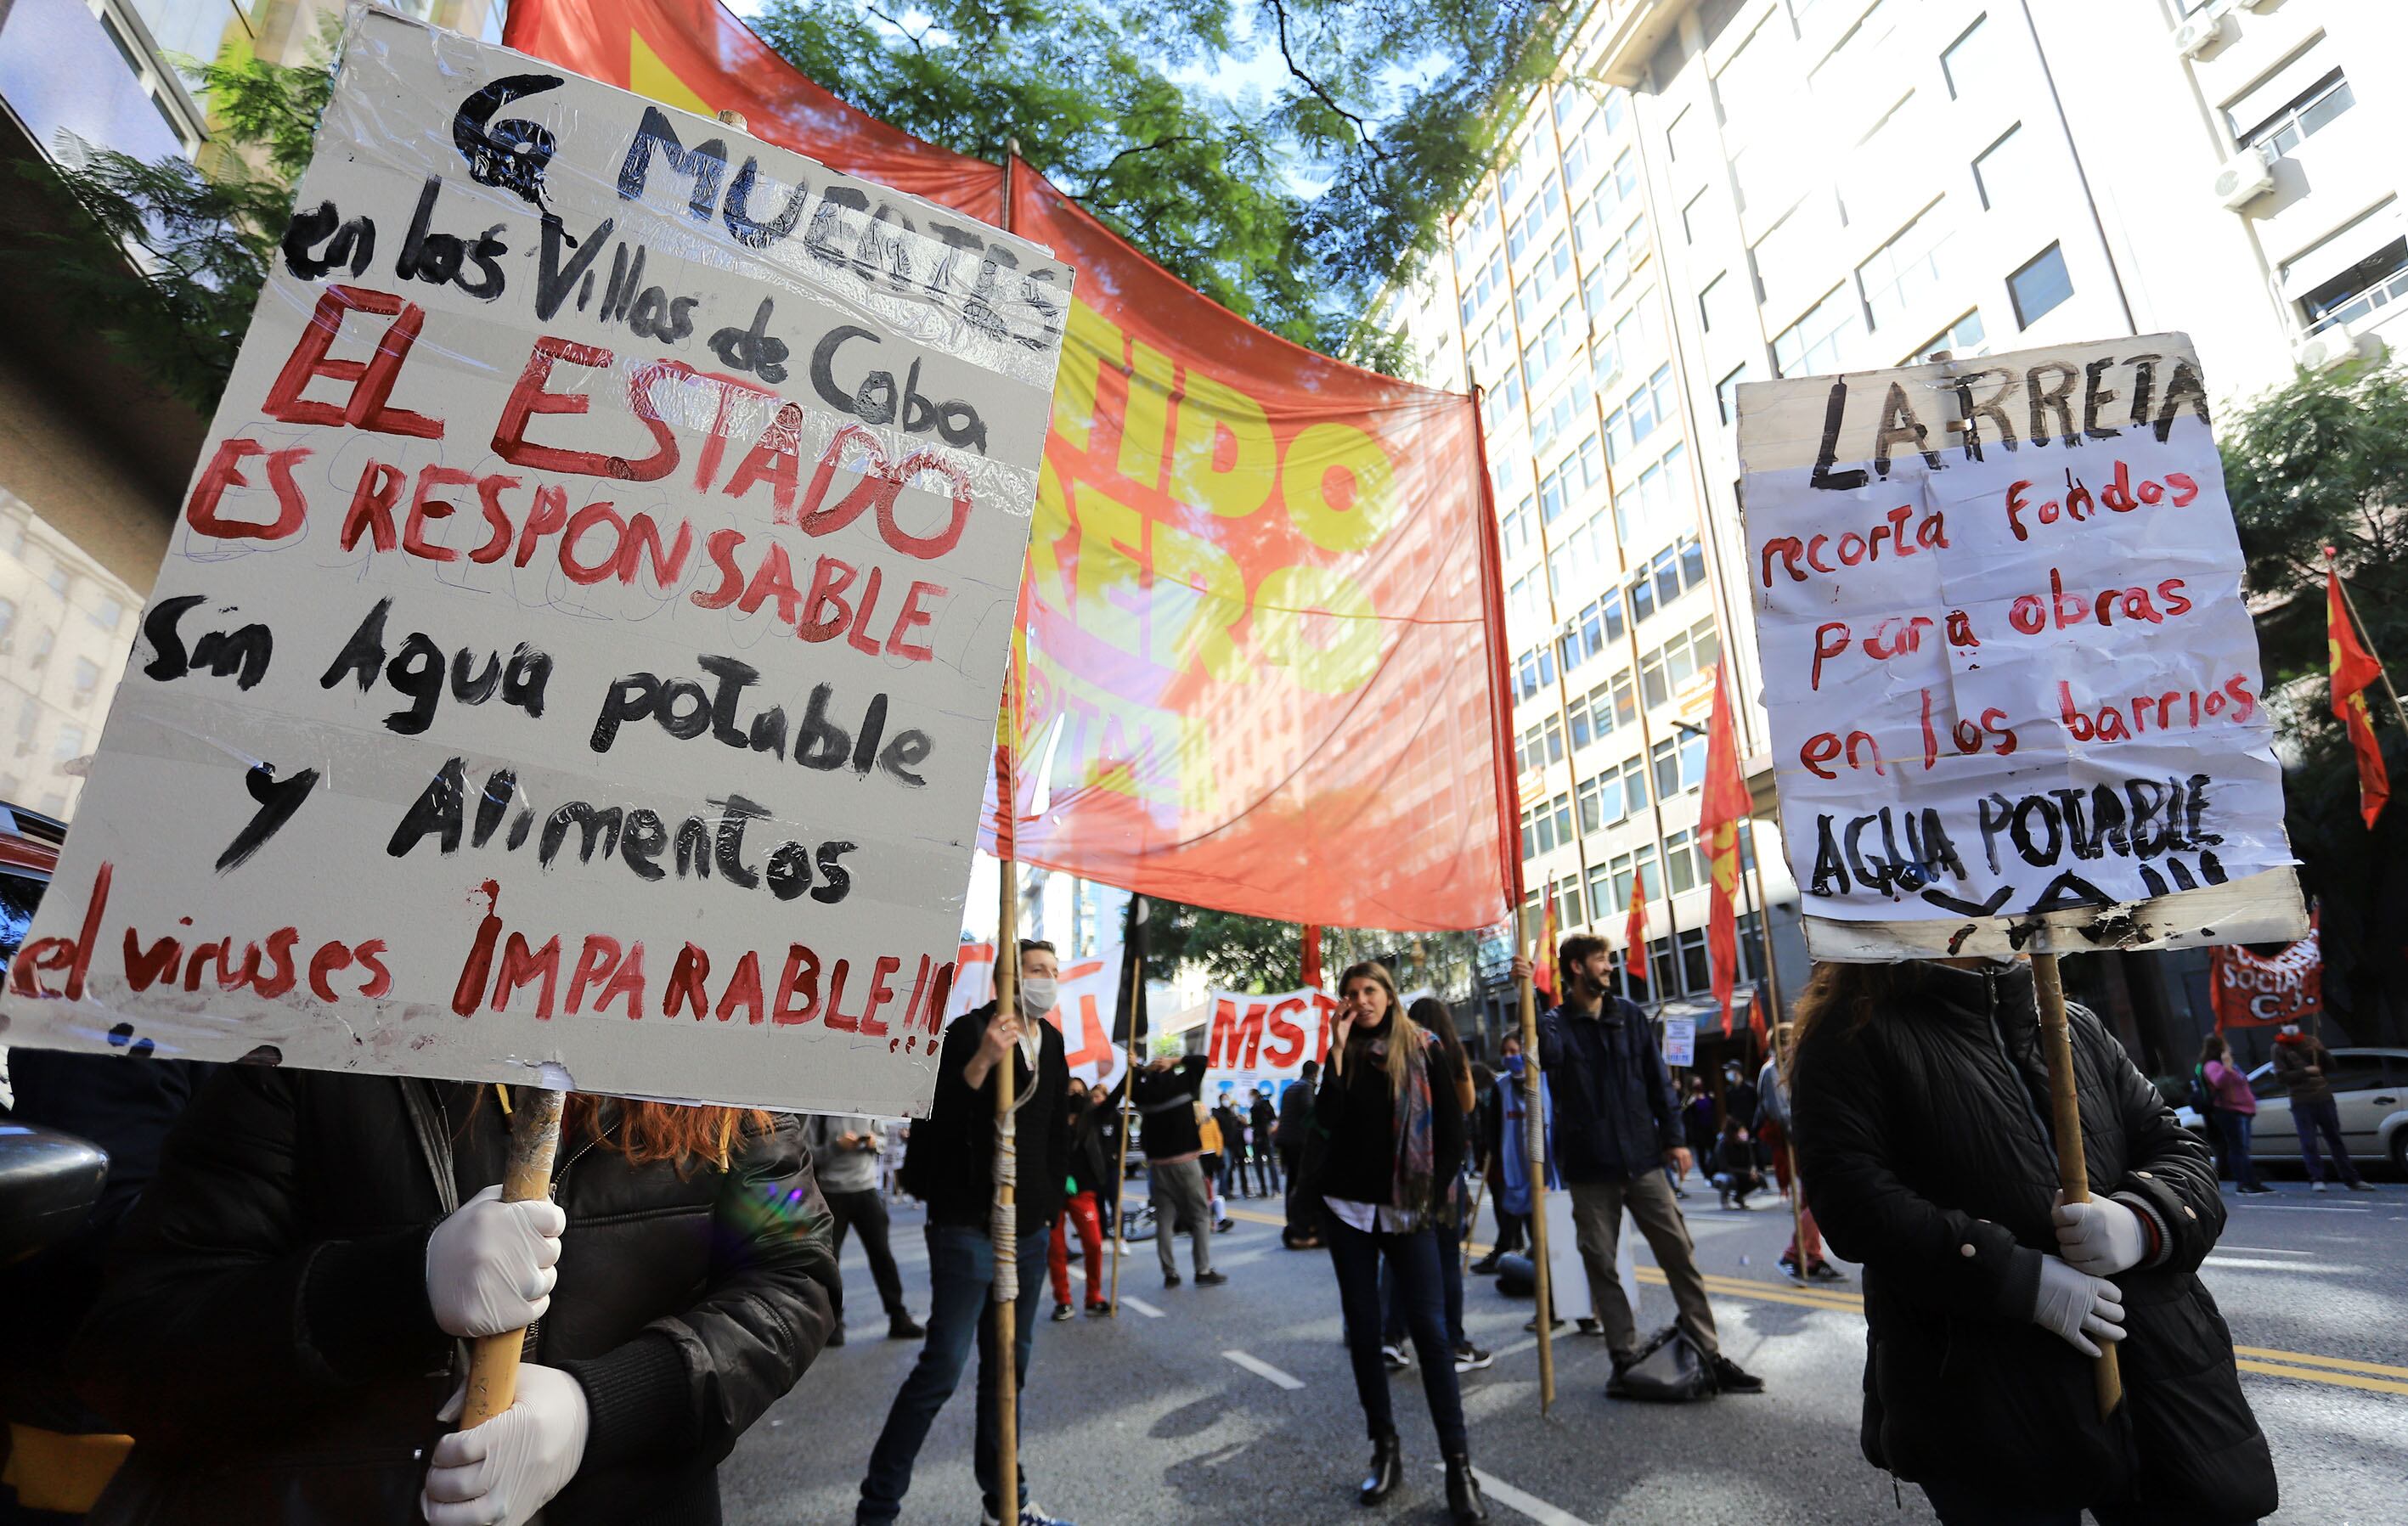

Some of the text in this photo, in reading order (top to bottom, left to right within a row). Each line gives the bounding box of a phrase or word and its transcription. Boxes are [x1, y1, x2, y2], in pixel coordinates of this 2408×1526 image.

[453, 74, 565, 204] 6
[283, 200, 375, 281] en
[536, 212, 700, 344] Villas
[708, 295, 789, 385] de
[809, 325, 988, 456] Caba
[262, 284, 973, 560] EL ESTADO
[1052, 296, 1395, 555] TIDO
[1811, 353, 2212, 491] LARRETA
[186, 438, 948, 662] ES RESPONSABLE
[1762, 504, 1950, 588] recorta
[144, 594, 932, 789] Sin Agua potable
[1811, 566, 2194, 691] para obras
[1799, 672, 2255, 780] en los barrios
[386, 755, 860, 904] Alimentos
[1811, 805, 1969, 898] AGUA
[1977, 773, 2225, 876] POTABLE
[8, 859, 114, 1002] el
[451, 876, 956, 1057] IMPARABLE!!!
[1208, 993, 1339, 1071] MST
